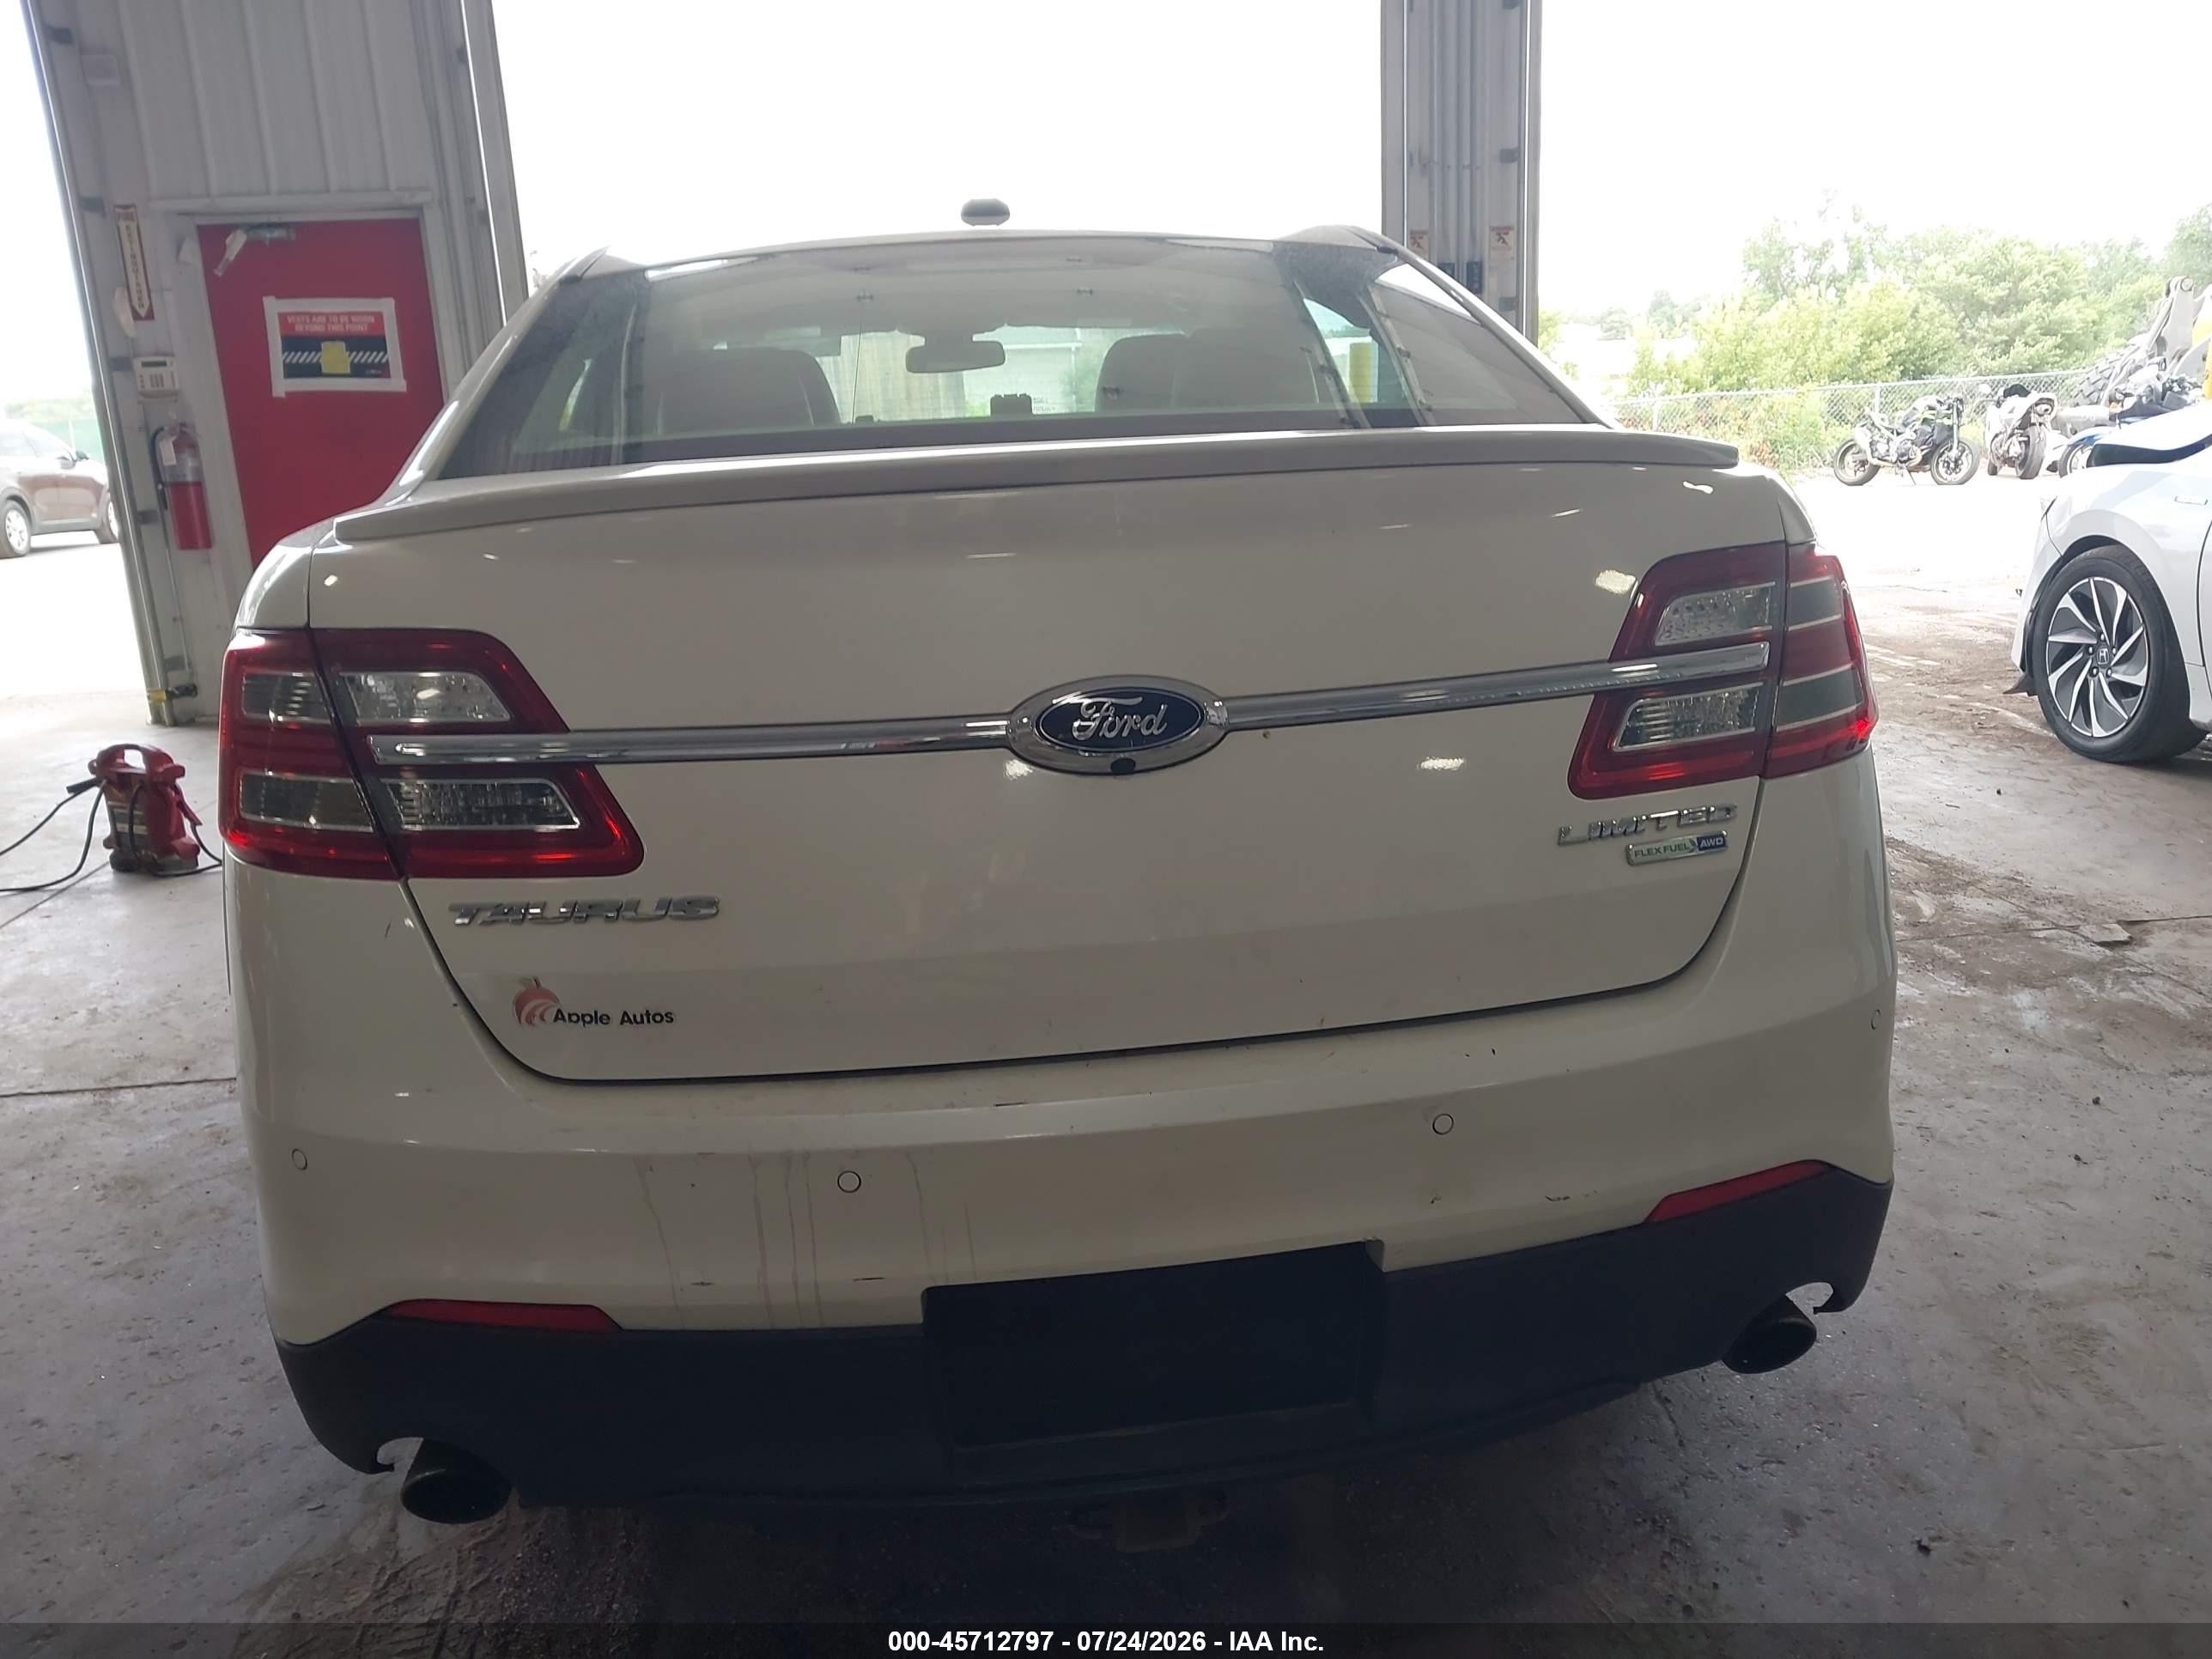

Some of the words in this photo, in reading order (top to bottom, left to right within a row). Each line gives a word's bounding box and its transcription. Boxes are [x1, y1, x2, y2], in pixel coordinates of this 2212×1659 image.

[1072, 696, 1168, 741] Ford
[1558, 804, 1737, 846] LIMITED
[1634, 846, 1662, 858] FLEX
[1662, 843, 1691, 854] FUEL
[1699, 836, 1724, 848] AWD
[448, 896, 720, 927] TAURUS
[553, 1008, 611, 1028] Apple
[619, 1009, 674, 1026] Autos
